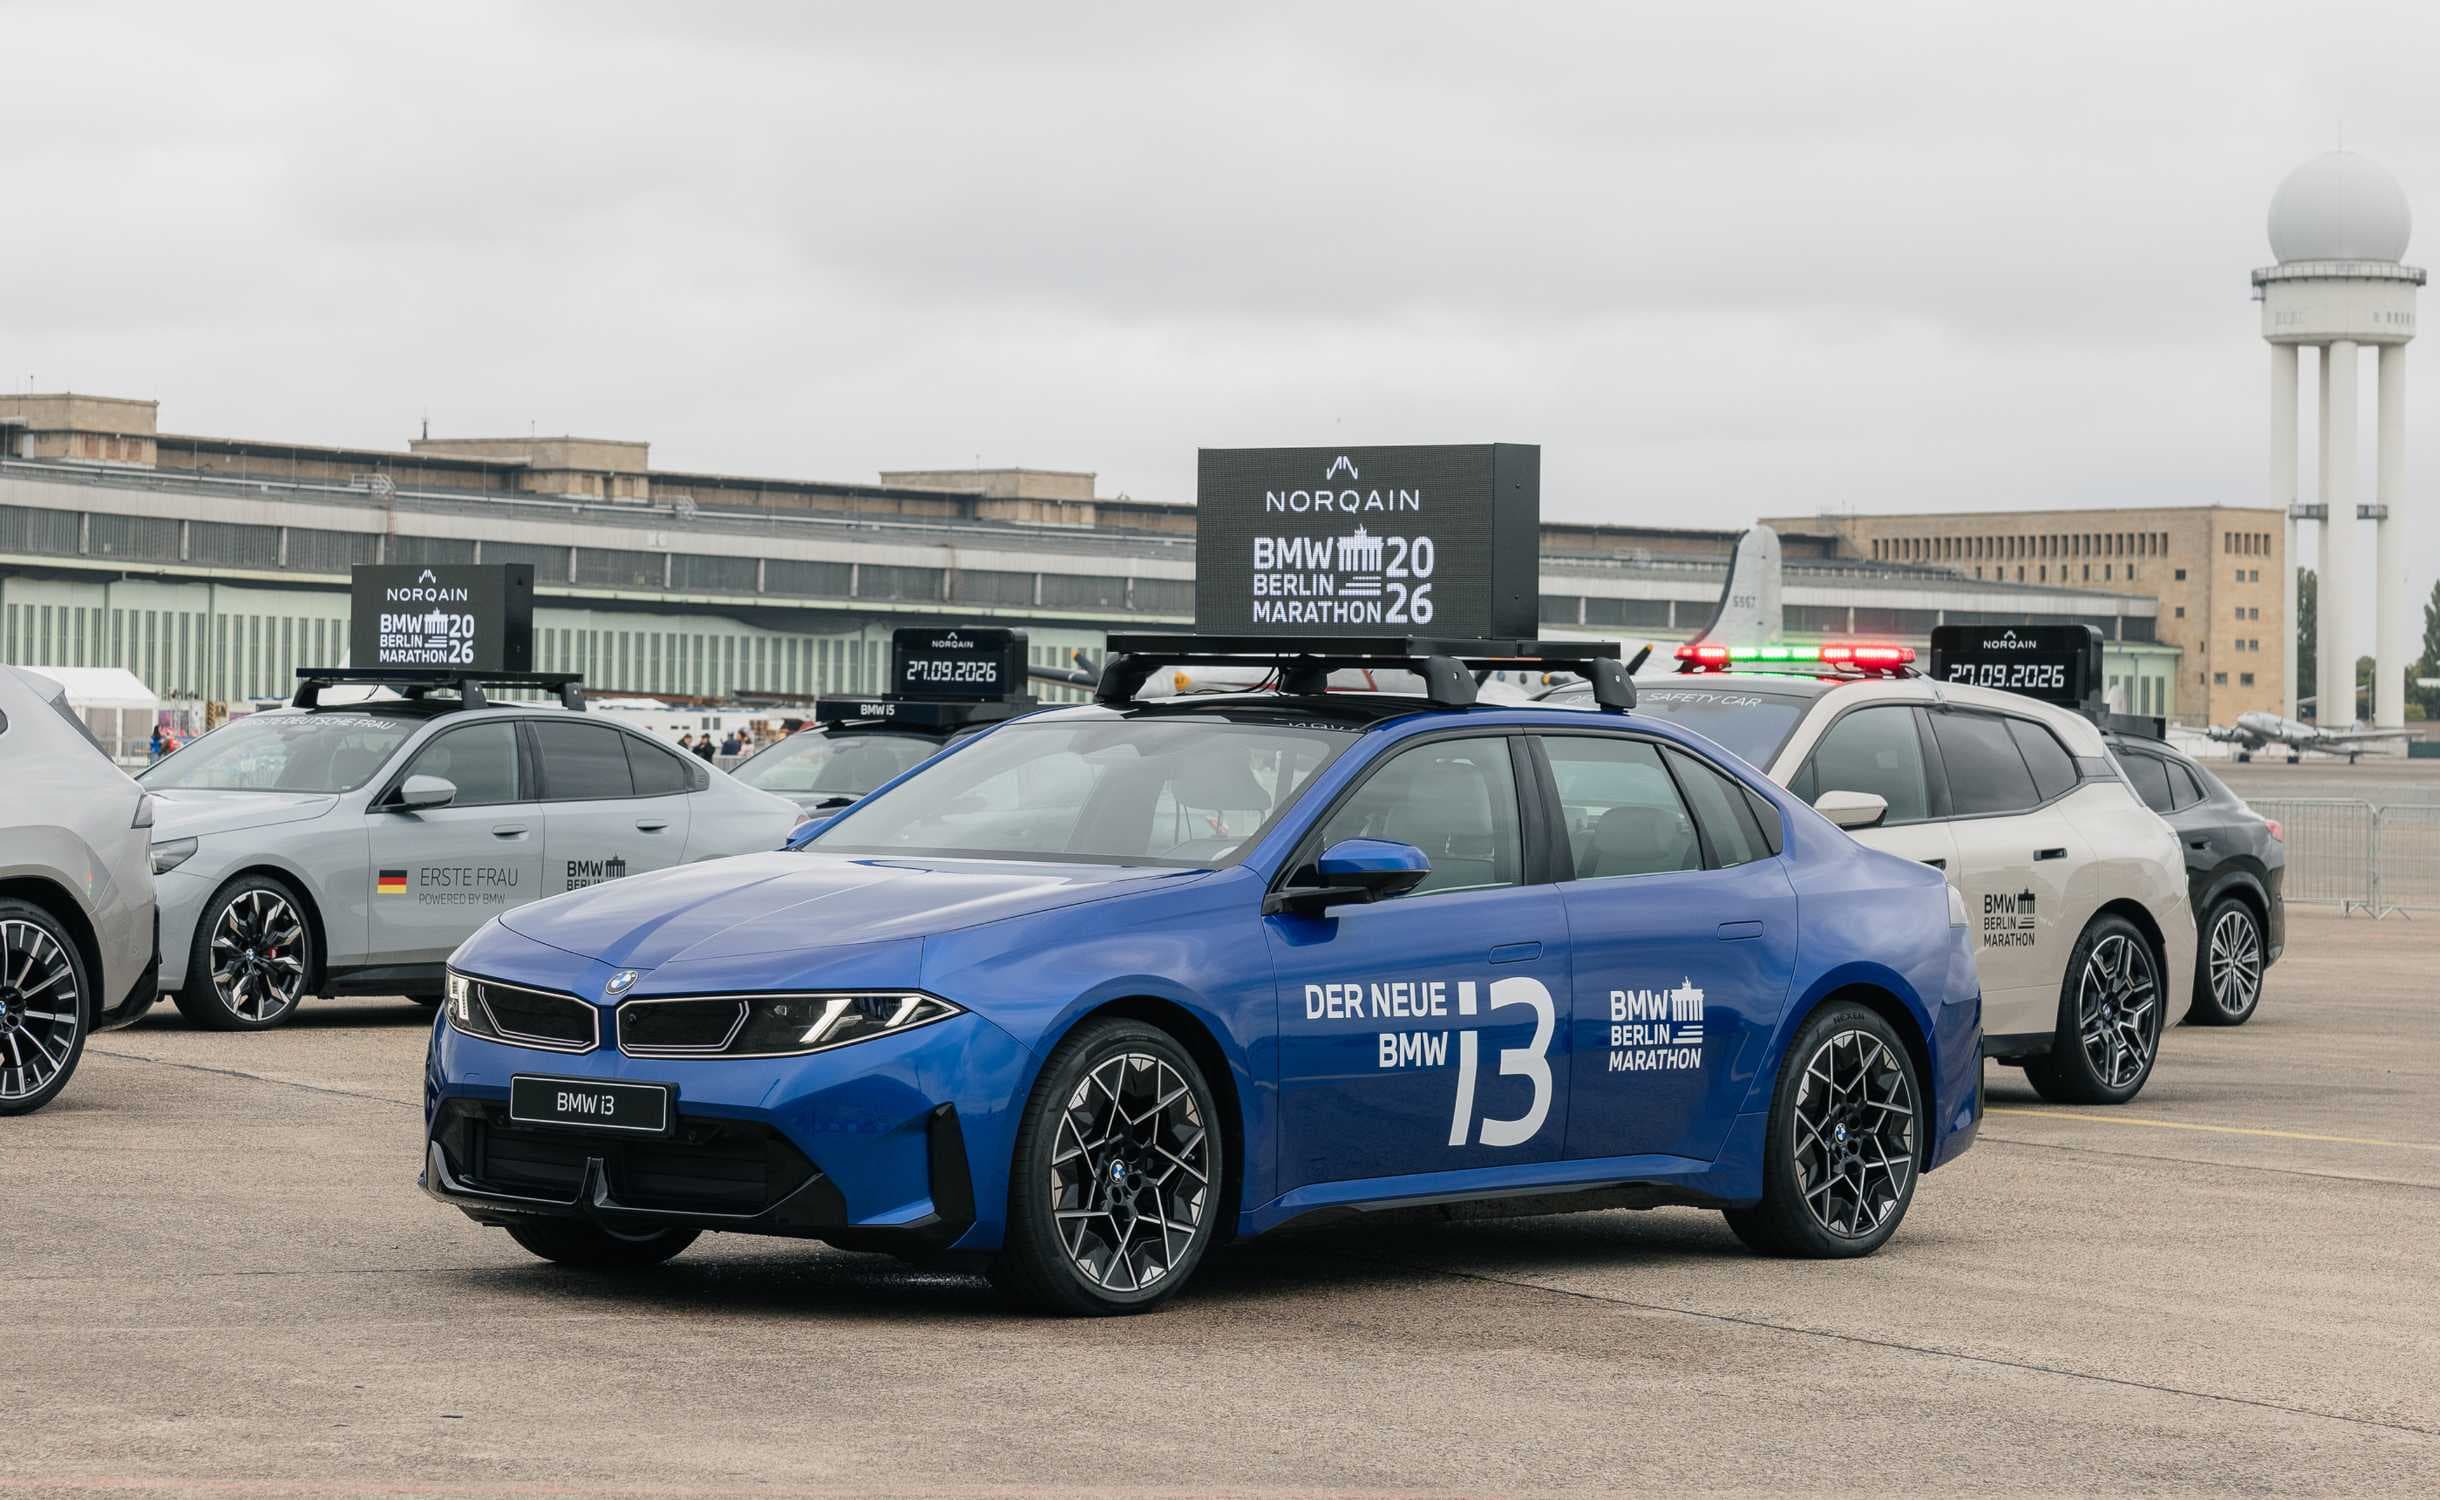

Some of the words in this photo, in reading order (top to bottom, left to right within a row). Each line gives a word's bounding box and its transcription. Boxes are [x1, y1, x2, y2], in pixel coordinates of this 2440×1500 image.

[1265, 489, 1420, 514] NORQAIN
[1253, 536, 1334, 570] BMW
[1385, 535, 1435, 578] 20
[386, 588, 468, 602] NORQAIN
[1253, 573, 1334, 597] BERLIN
[1385, 582, 1434, 625] 26
[1253, 600, 1382, 624] MARATHON
[380, 613, 423, 633] BMW
[448, 614, 475, 638] 20
[379, 649, 448, 663] MARATHON
[380, 634, 423, 648] BERLIN
[448, 639, 474, 664] 26
[932, 640, 974, 649] NORQAIN
[1983, 639, 2037, 650] NORQAIN
[906, 660, 996, 682] 27.09.2026
[1949, 664, 2065, 688] 27.09.2026
[860, 704, 884, 716] BMW
[1646, 692, 1722, 704] SAFETY
[1720, 695, 1762, 707] CAR
[420, 867, 472, 887] ERSTE
[476, 867, 519, 887] FRAU
[567, 860, 604, 877] BMW
[418, 892, 466, 905] POWERED
[468, 892, 482, 905] BY
[483, 892, 506, 905] BMW
[1984, 893, 2017, 914] BMW
[1983, 917, 2017, 930] BERLIN
[1983, 933, 2036, 947] MARATHON
[1304, 984, 1365, 1020] DER
[1370, 981, 1449, 1018] NEUE
[1610, 989, 1669, 1021] BMW
[1610, 1023, 1670, 1047] BERLIN
[1378, 1031, 1449, 1068] BMW
[1448, 976, 1556, 1147] i3
[1608, 1047, 1703, 1072] MARATHON
[556, 1091, 598, 1114] BMW
[600, 1094, 615, 1116] i3
